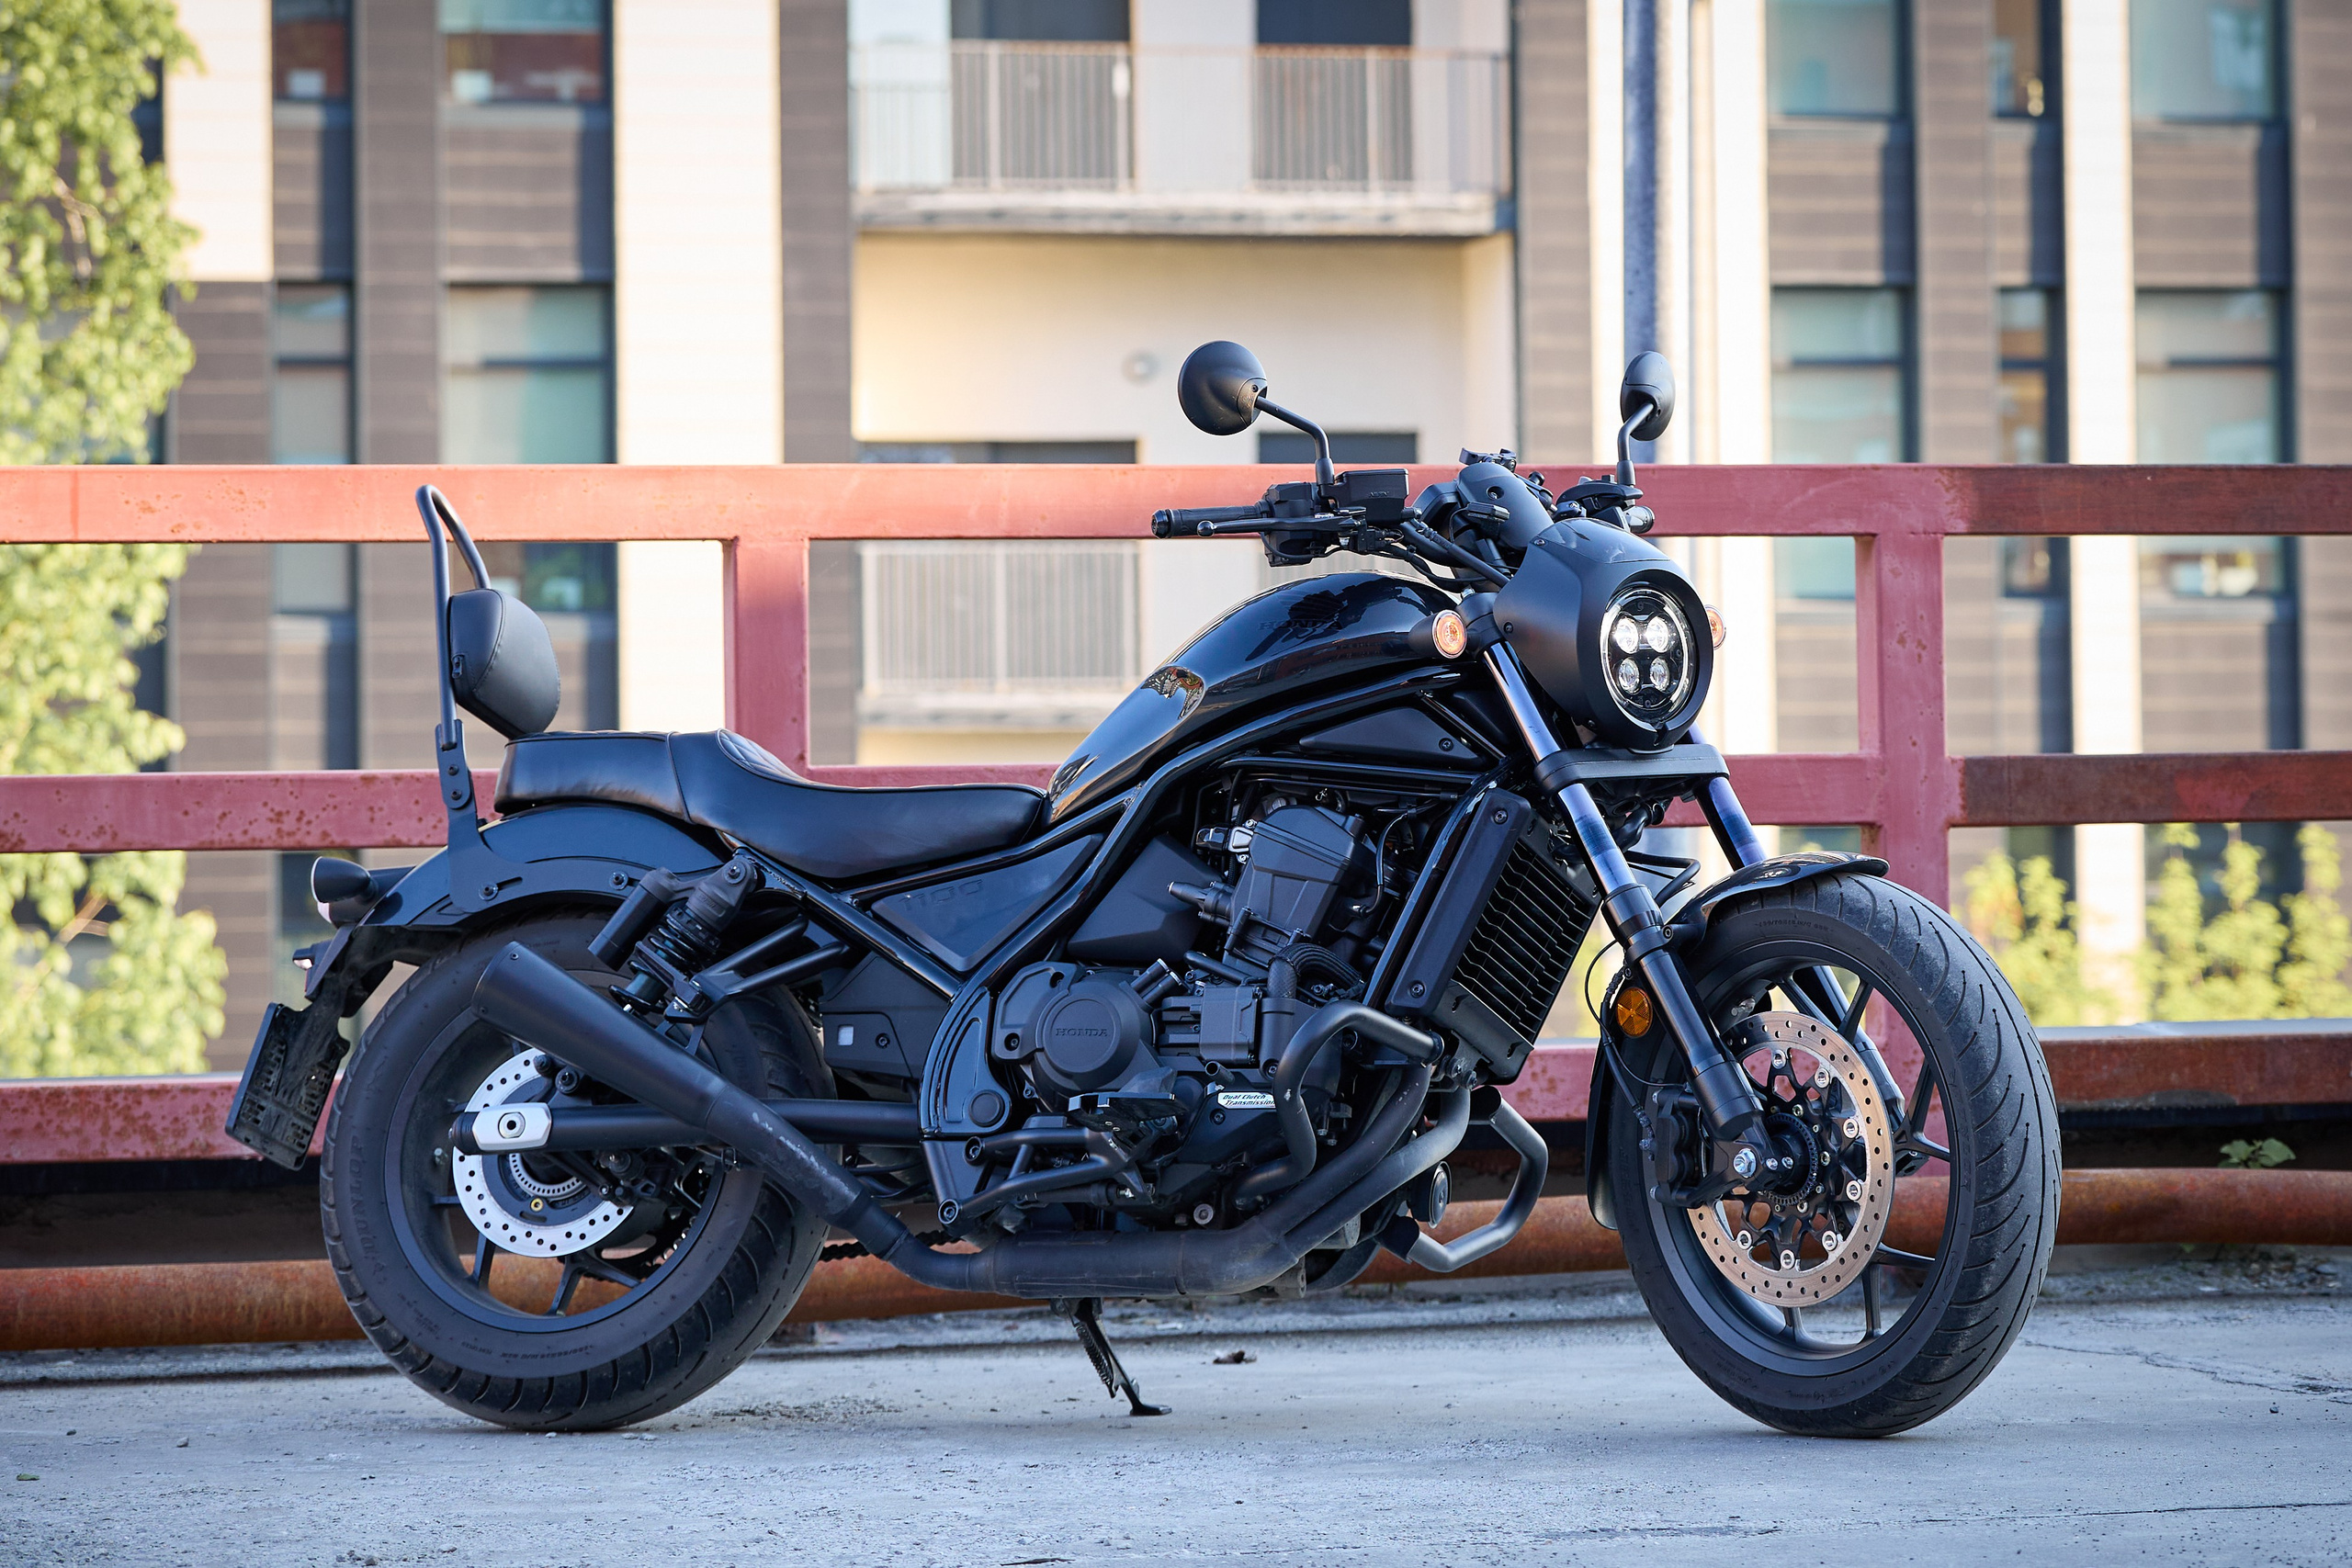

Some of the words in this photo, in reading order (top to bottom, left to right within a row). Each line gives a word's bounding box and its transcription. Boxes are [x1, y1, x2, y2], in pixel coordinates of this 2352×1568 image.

[1258, 619, 1343, 630] HONDA
[898, 879, 984, 910] 1100
[1055, 1027, 1108, 1036] HONDA
[349, 1134, 374, 1250] DUNLOP
